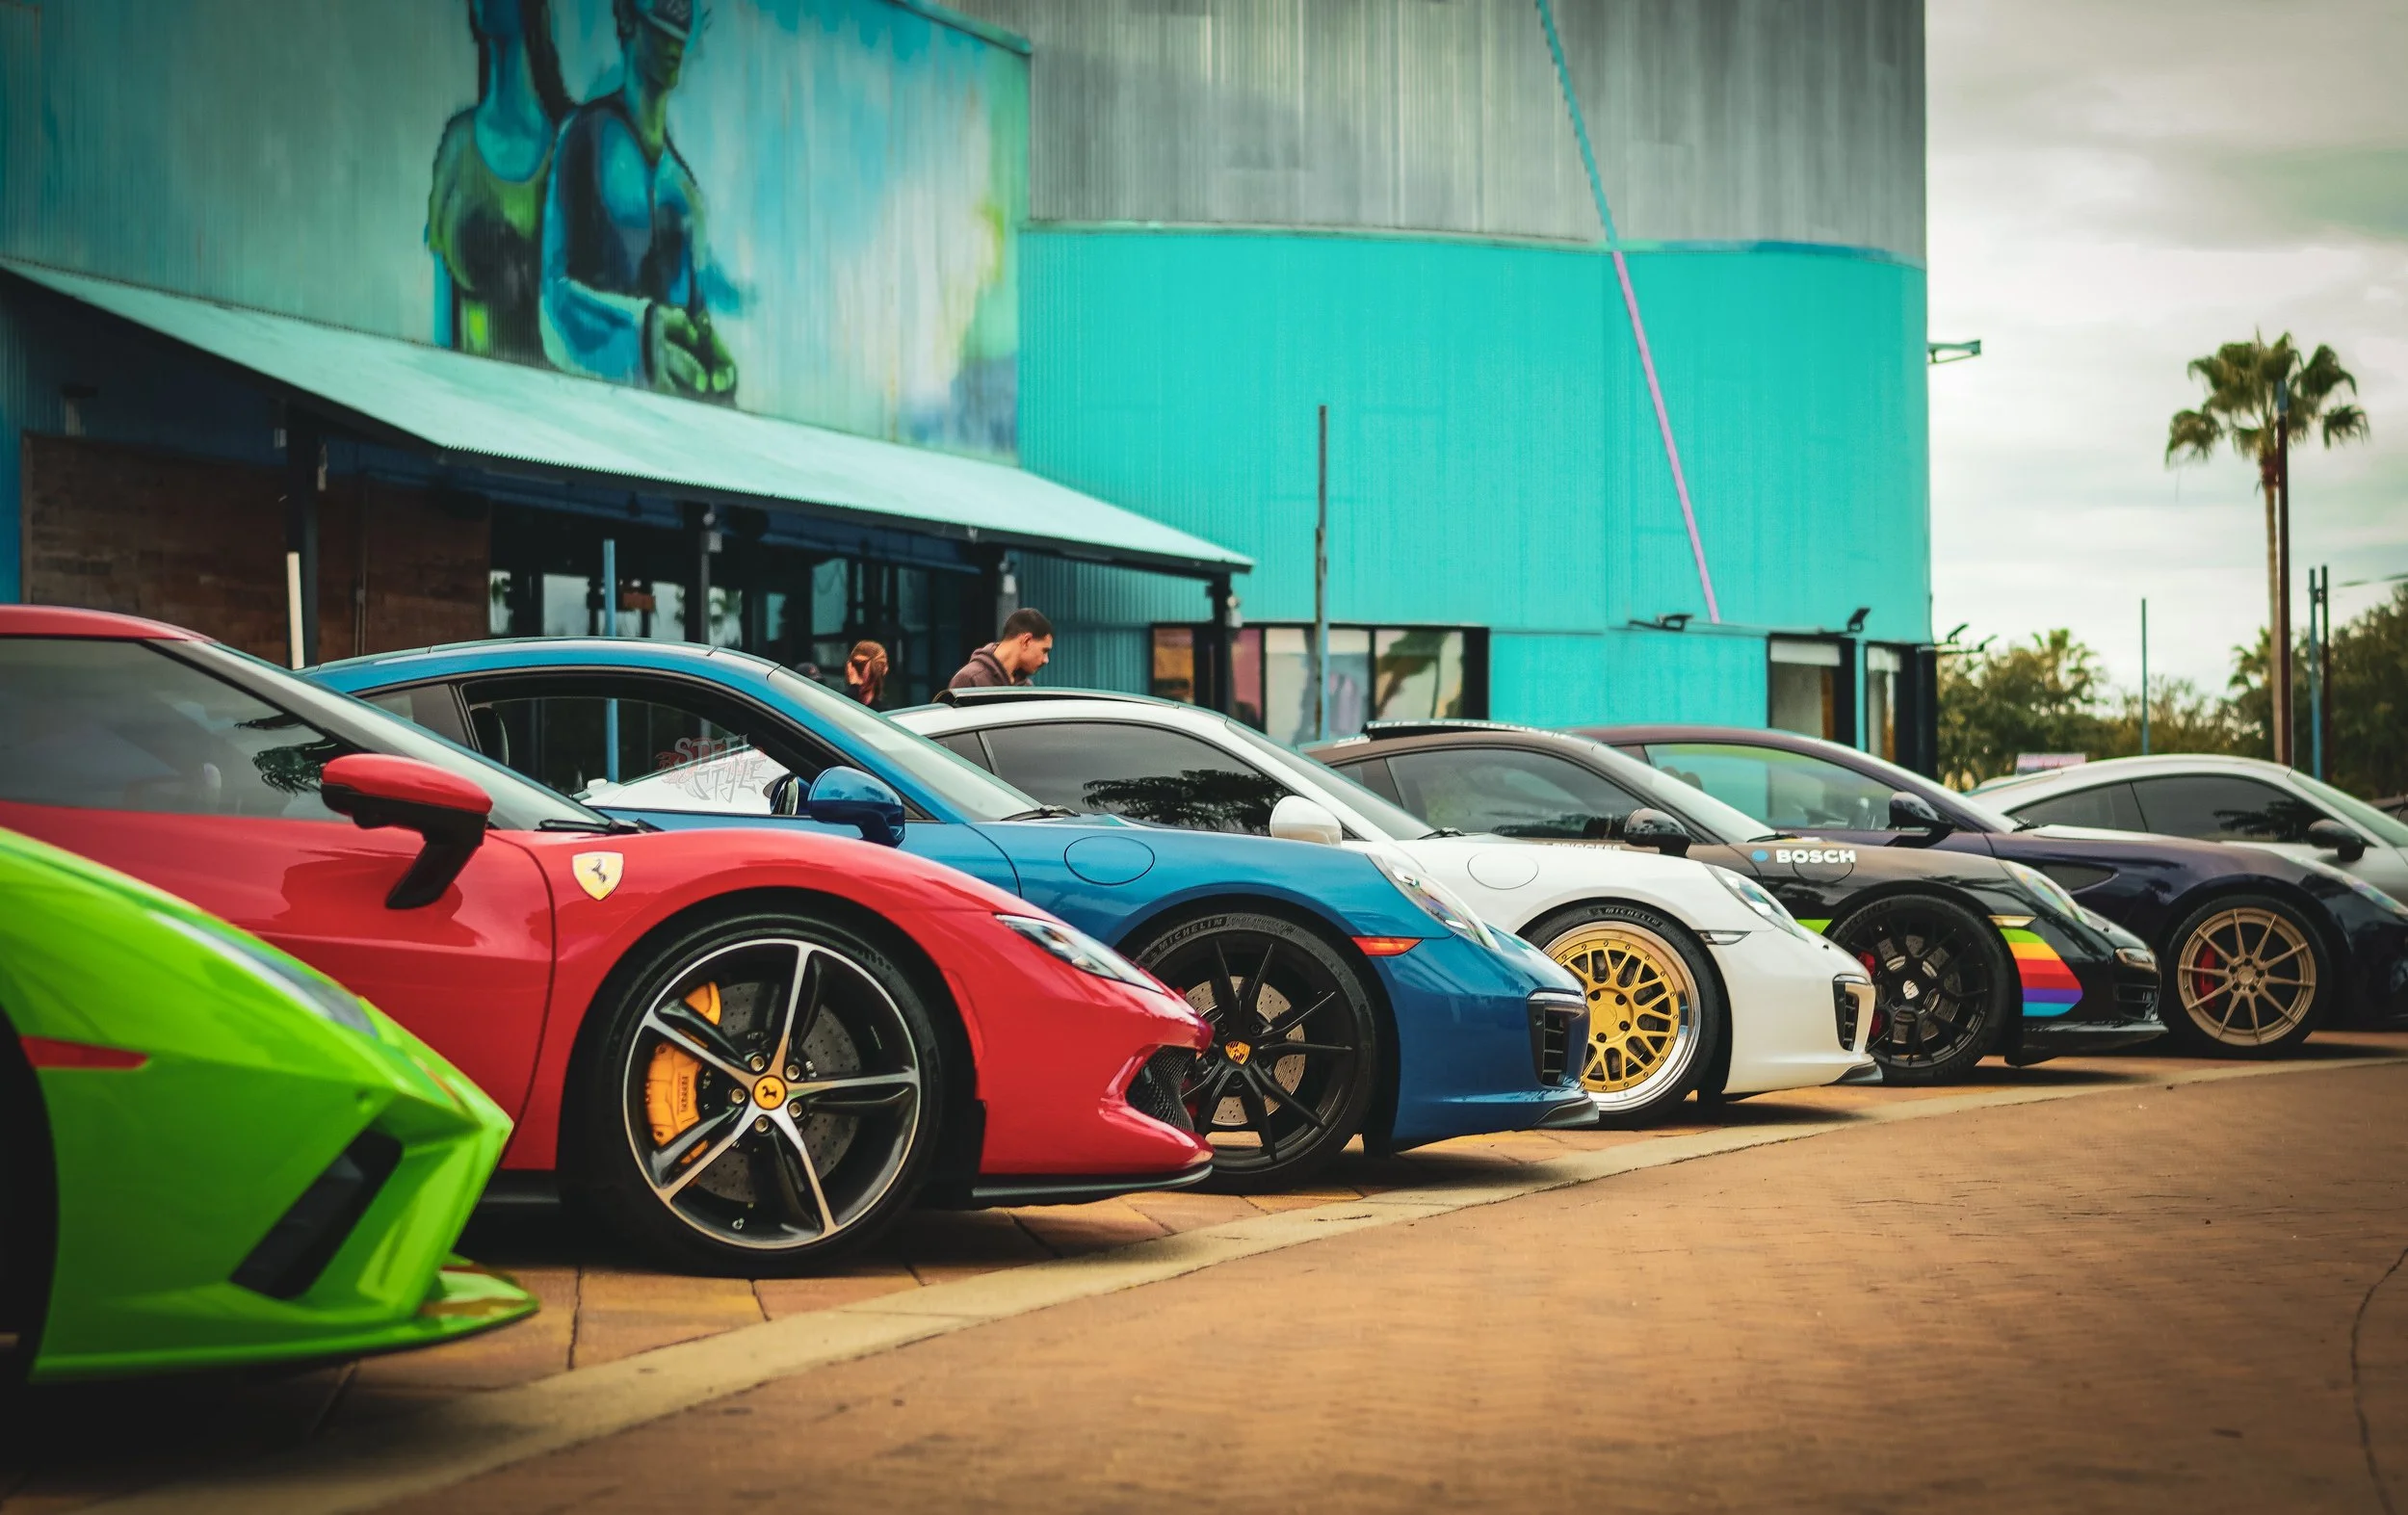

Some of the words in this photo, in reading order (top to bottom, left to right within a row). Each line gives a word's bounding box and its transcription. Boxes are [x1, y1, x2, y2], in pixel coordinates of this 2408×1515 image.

[674, 733, 751, 767] STEEL
[692, 757, 768, 803] STYLE
[1775, 849, 1856, 864] BOSCH
[1158, 918, 1223, 952] MICHELIN
